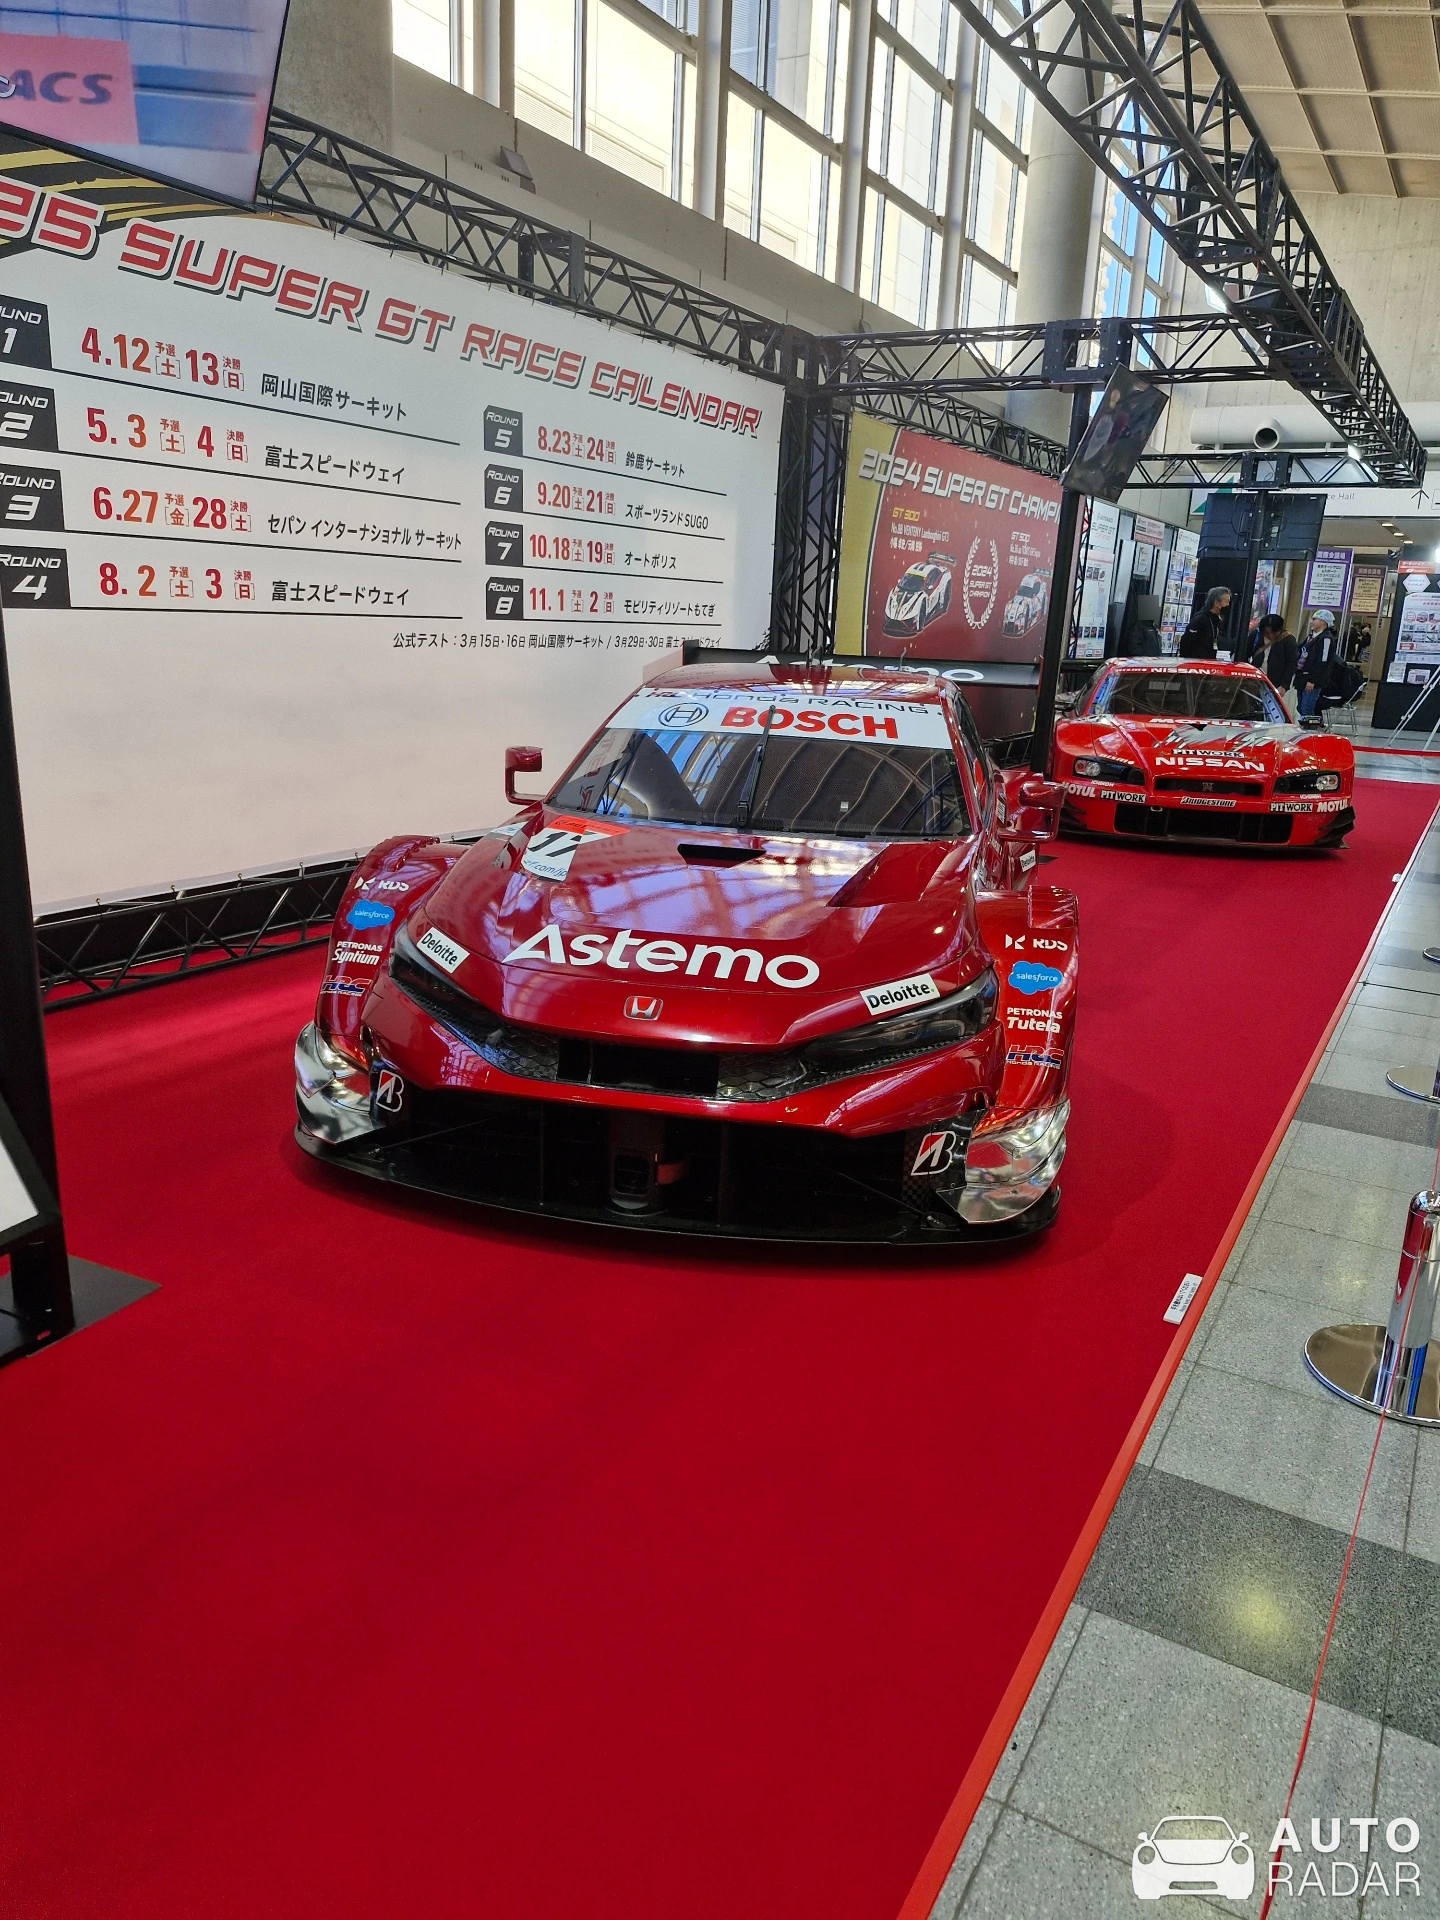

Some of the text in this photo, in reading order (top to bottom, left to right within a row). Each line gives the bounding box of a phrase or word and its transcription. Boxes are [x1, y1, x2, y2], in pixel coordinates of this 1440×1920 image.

[0, 306, 42, 325] UND
[118, 222, 368, 330] SUPER
[376, 297, 454, 349] GT
[461, 323, 585, 388] RACE
[589, 361, 762, 437] CALENDAR
[3, 328, 17, 354] 1
[82, 327, 151, 374] 4.12
[155, 342, 176, 357] 予選
[186, 349, 220, 386] 13
[222, 356, 241, 370] 決勝
[261, 373, 407, 421] 岡山国際サーキット
[0, 412, 33, 440] 2
[486, 412, 518, 426] ROUND
[495, 428, 512, 448] 5
[160, 418, 180, 432] 予選
[197, 426, 214, 458] 4
[226, 429, 245, 442] 決勝
[265, 445, 405, 485] 富士スピードウェイ
[538, 426, 570, 455] 8.23
[573, 433, 583, 443] 予選
[587, 437, 604, 462] 24
[606, 440, 615, 449] 決勝
[625, 451, 685, 478] 鈴鹿サーキット
[487, 470, 519, 483] ROUND
[859, 448, 922, 489] 2024
[921, 466, 987, 506] SUPER
[985, 484, 1010, 510] GT
[494, 486, 512, 505] 6
[5, 494, 40, 520] 3
[538, 482, 570, 509] 9.20
[573, 487, 583, 496] 予選
[586, 489, 603, 514] 21
[605, 492, 615, 501] 決勝
[625, 504, 709, 530] スポーツランドSUGO
[892, 507, 920, 522] GT 300
[93, 486, 158, 523] 6.27
[164, 493, 185, 506] 予選
[192, 496, 227, 530] 28
[230, 500, 248, 512] 決勝
[268, 514, 307, 535] セパン
[311, 519, 412, 546] インターナショナル
[415, 529, 462, 550] サーキット
[488, 527, 520, 538] ROUND
[497, 542, 512, 560] 7
[530, 534, 570, 560] 10.18
[572, 539, 582, 548] 予選
[587, 540, 602, 563] 19
[605, 543, 614, 551] 決勝
[625, 551, 676, 569] オートポリス
[0, 553, 61, 569] ROUND
[972, 565, 992, 577] 2024
[11, 575, 48, 600] 4
[170, 566, 189, 578] 予選
[205, 568, 222, 599] 3
[234, 570, 252, 581] 決勝
[272, 580, 410, 606] 富士スピードウェイ
[488, 582, 520, 592] ROUND
[495, 596, 514, 614] 8
[572, 590, 582, 598] 予選
[590, 591, 598, 613] 2
[624, 600, 716, 617] モビリティリゾートもてぎ
[528, 634, 604, 648] 岡山国際サーキット
[809, 698, 928, 714] RACING
[720, 706, 898, 739] BOSCH
[1150, 718, 1245, 727] MOTUL
[1099, 754, 1135, 765] nismo
[1155, 757, 1264, 772] NISSAN
[1285, 765, 1318, 774] nismo
[1181, 796, 1236, 807] BRIDGESTONE
[1317, 799, 1348, 812] MOTUL
[355, 910, 390, 919] salesforce
[337, 941, 383, 952] PETRONAS
[332, 948, 380, 965] Syntium
[501, 925, 820, 989] Astemo
[322, 975, 374, 994] HRC
[1016, 972, 1058, 982] salesforce
[1007, 1008, 1062, 1018] PETRONAS
[1007, 1017, 1060, 1033] Tutela
[1007, 1044, 1064, 1064] HRC
